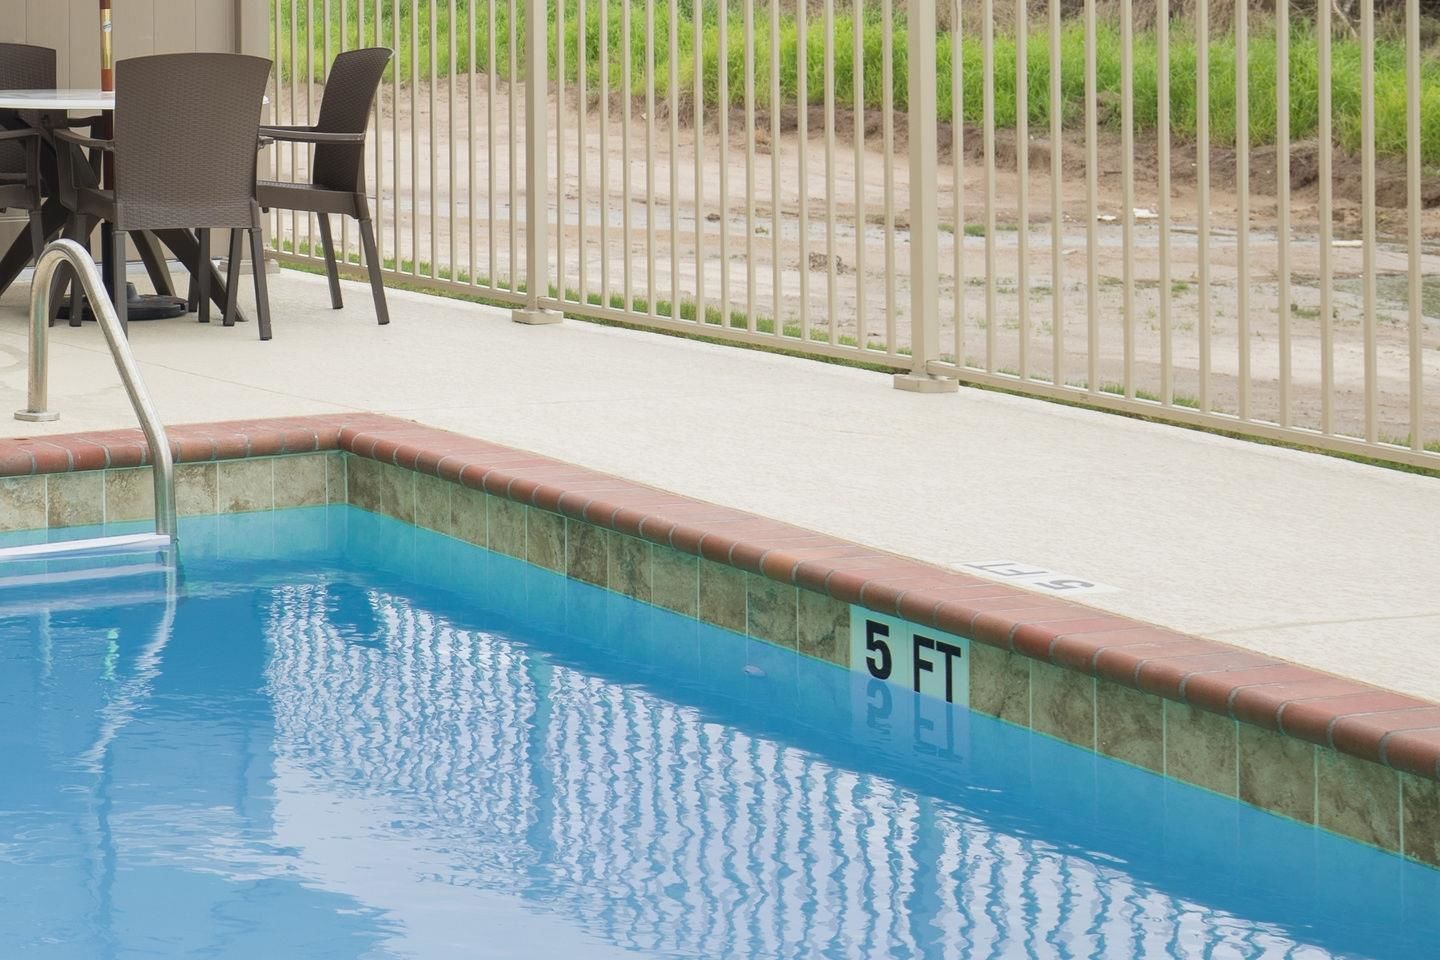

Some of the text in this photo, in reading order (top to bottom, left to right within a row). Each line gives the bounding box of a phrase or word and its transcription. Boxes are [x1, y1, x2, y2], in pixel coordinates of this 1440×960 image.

[963, 562, 1049, 576] FT
[866, 619, 961, 704] 5 FT
